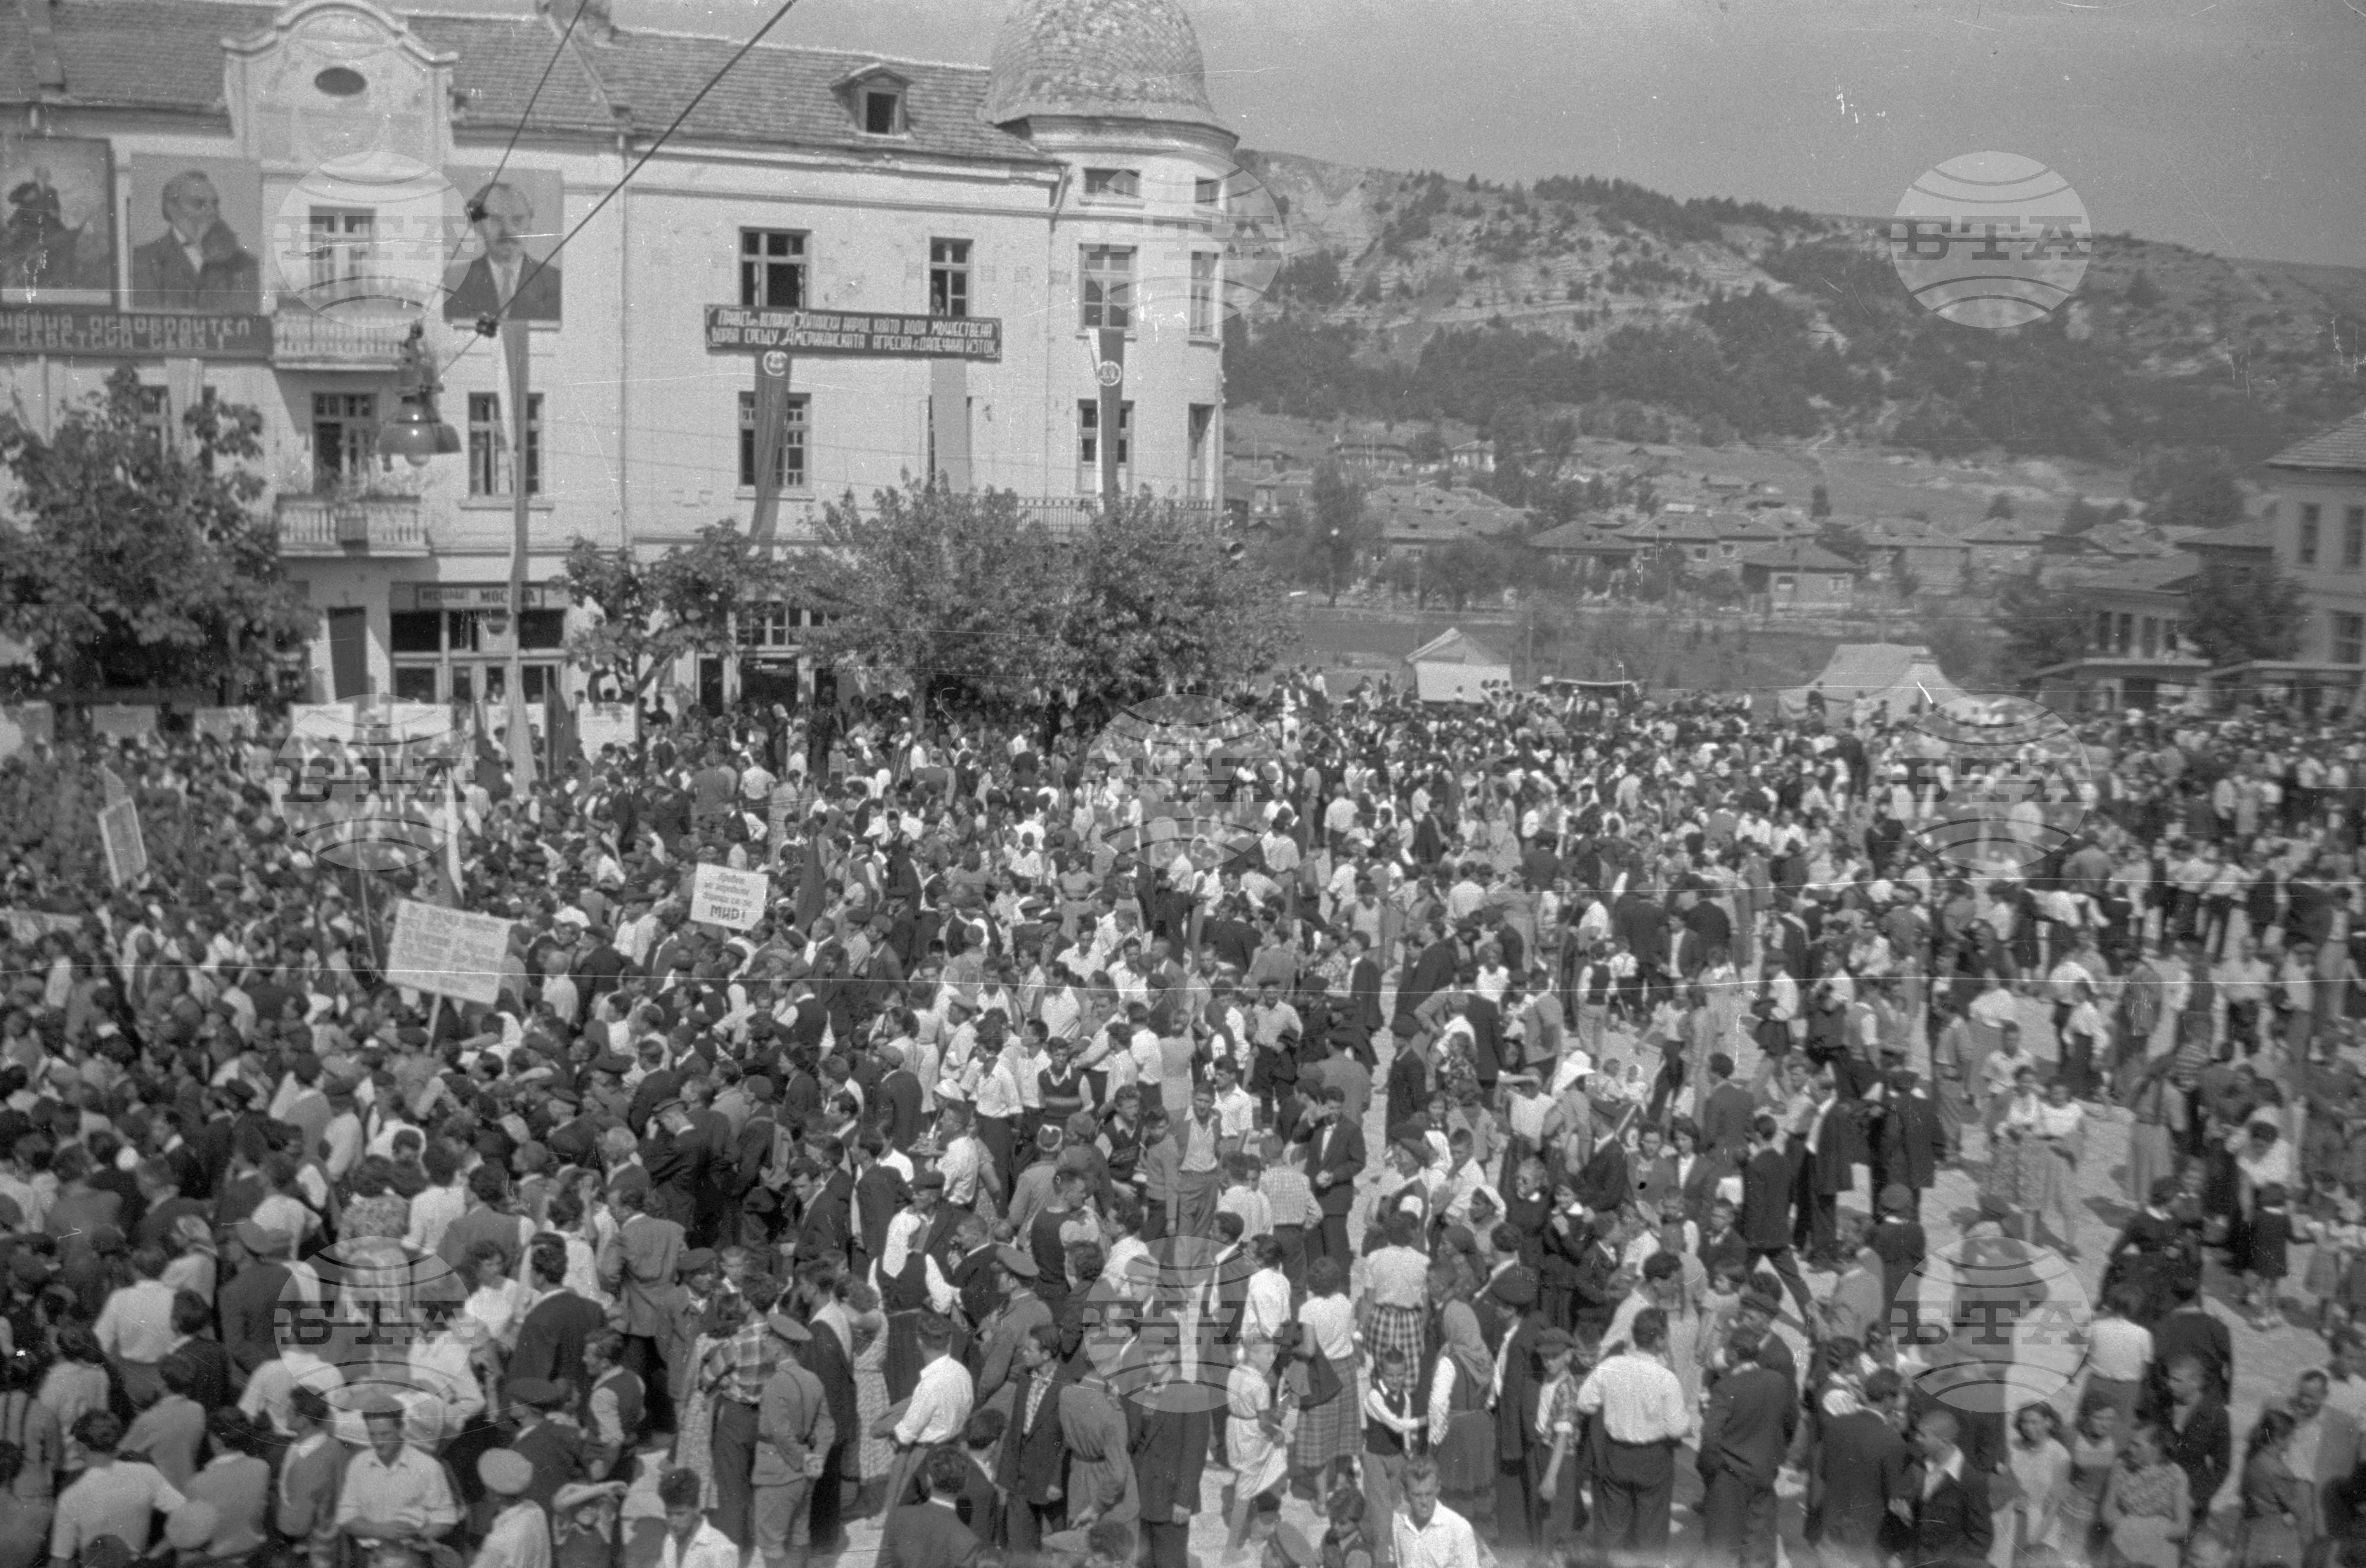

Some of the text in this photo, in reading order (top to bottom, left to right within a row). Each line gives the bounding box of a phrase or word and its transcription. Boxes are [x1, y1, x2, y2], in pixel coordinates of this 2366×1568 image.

[903, 319, 927, 335] ВОДИ
[930, 320, 993, 338] МЪЖЕСТВЕНА
[744, 328, 779, 346] СРЕЩУ
[779, 328, 865, 349] АМЕРИКАНСКАТА
[872, 335, 913, 352] АГРЕСИЯ
[480, 590, 537, 604] МОСВА
[710, 904, 746, 922] МИР!
